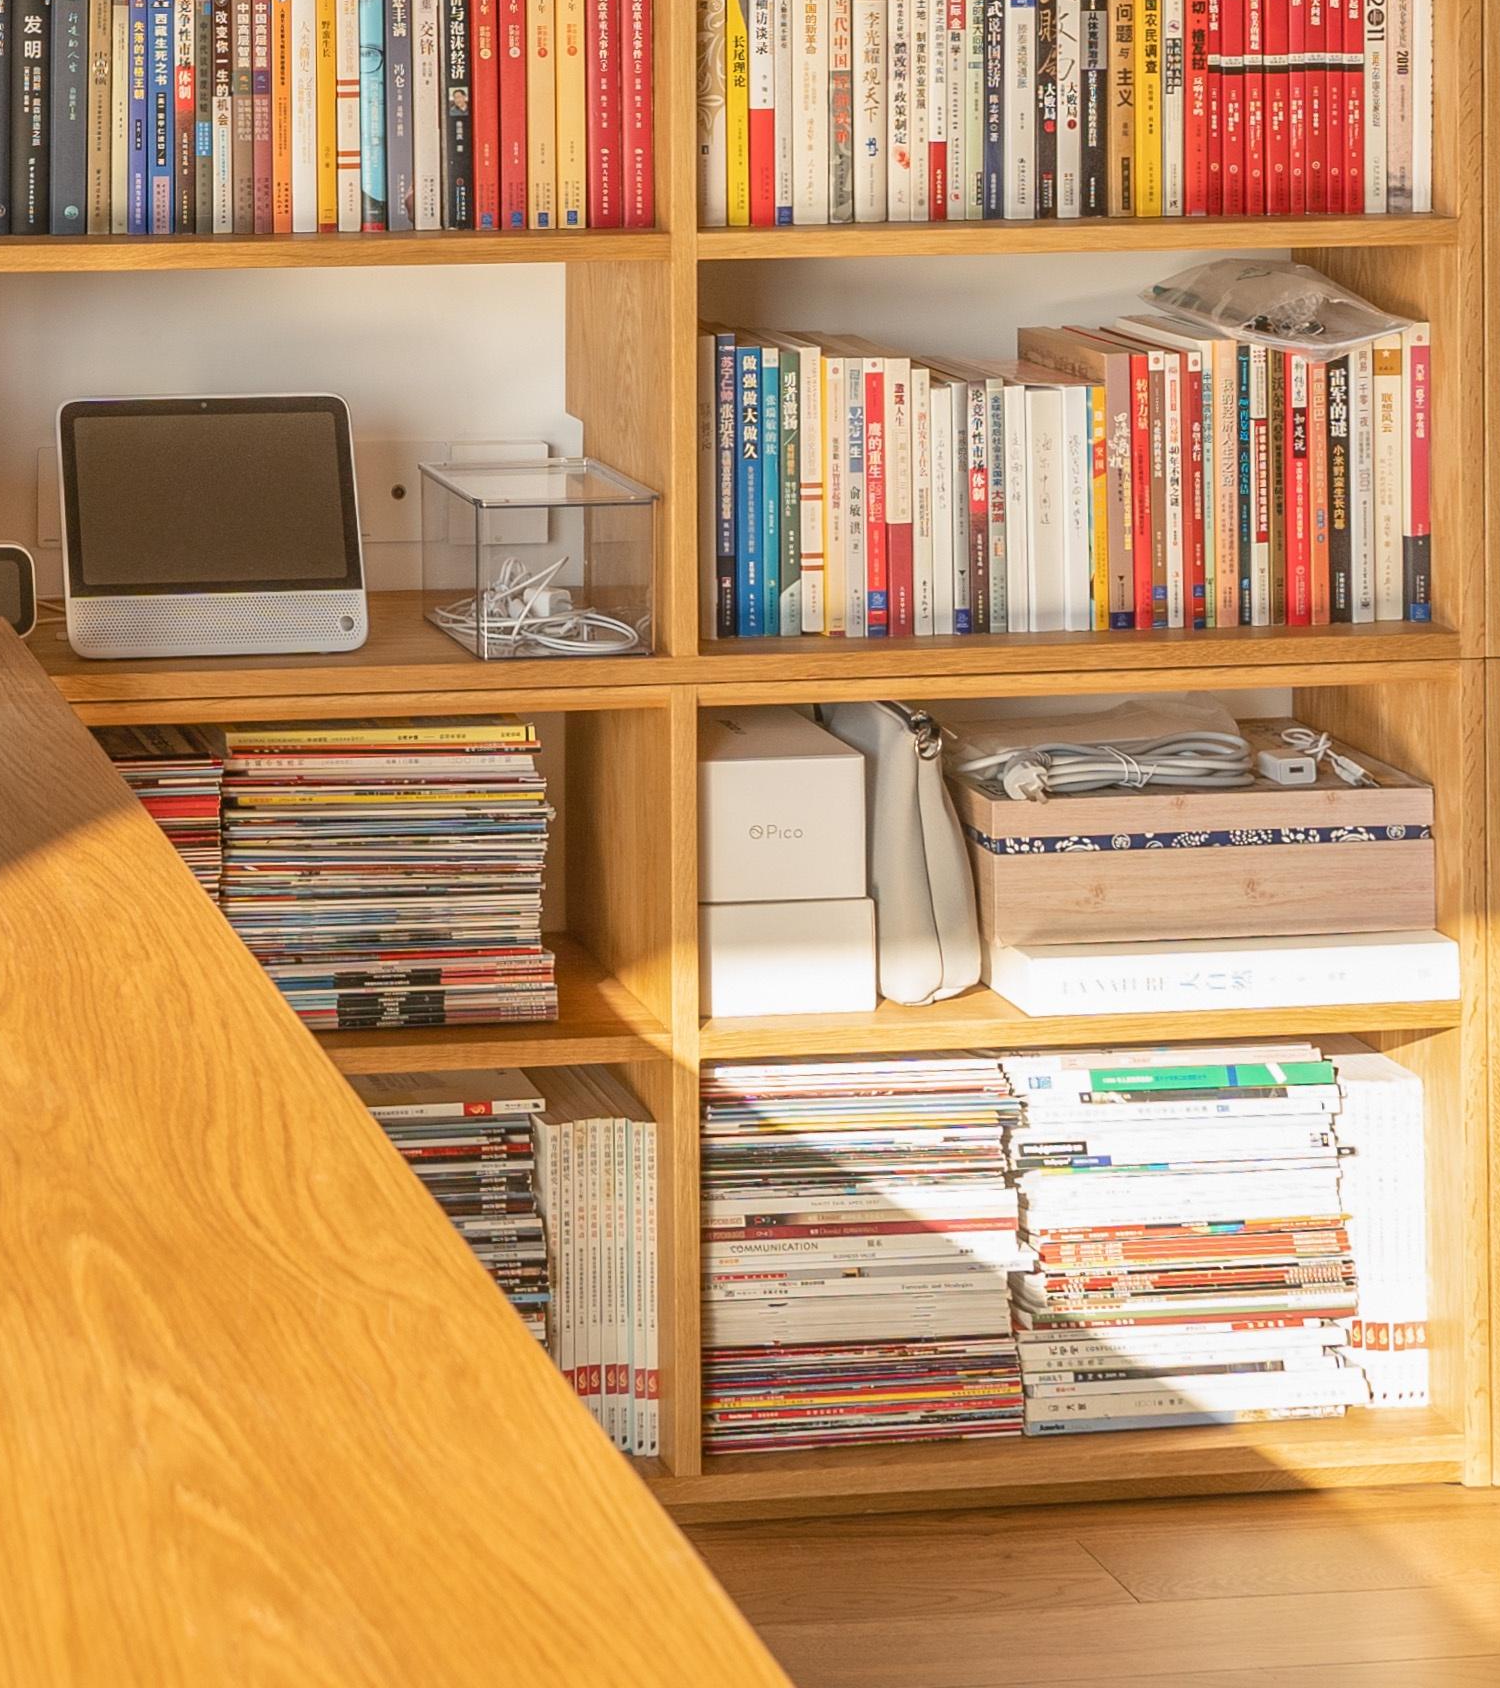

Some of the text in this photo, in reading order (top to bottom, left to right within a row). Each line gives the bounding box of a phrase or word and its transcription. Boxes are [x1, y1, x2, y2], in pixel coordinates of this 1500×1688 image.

[24, 16, 43, 59] 发明
[1116, 3, 1133, 108] 问题与主义
[732, 35, 745, 87] 长尾理论
[1398, 52, 1408, 75] 2010
[742, 355, 757, 459] 做强做大做久
[767, 825, 803, 839] Pico
[730, 1241, 819, 1254] COMMUNICATION
